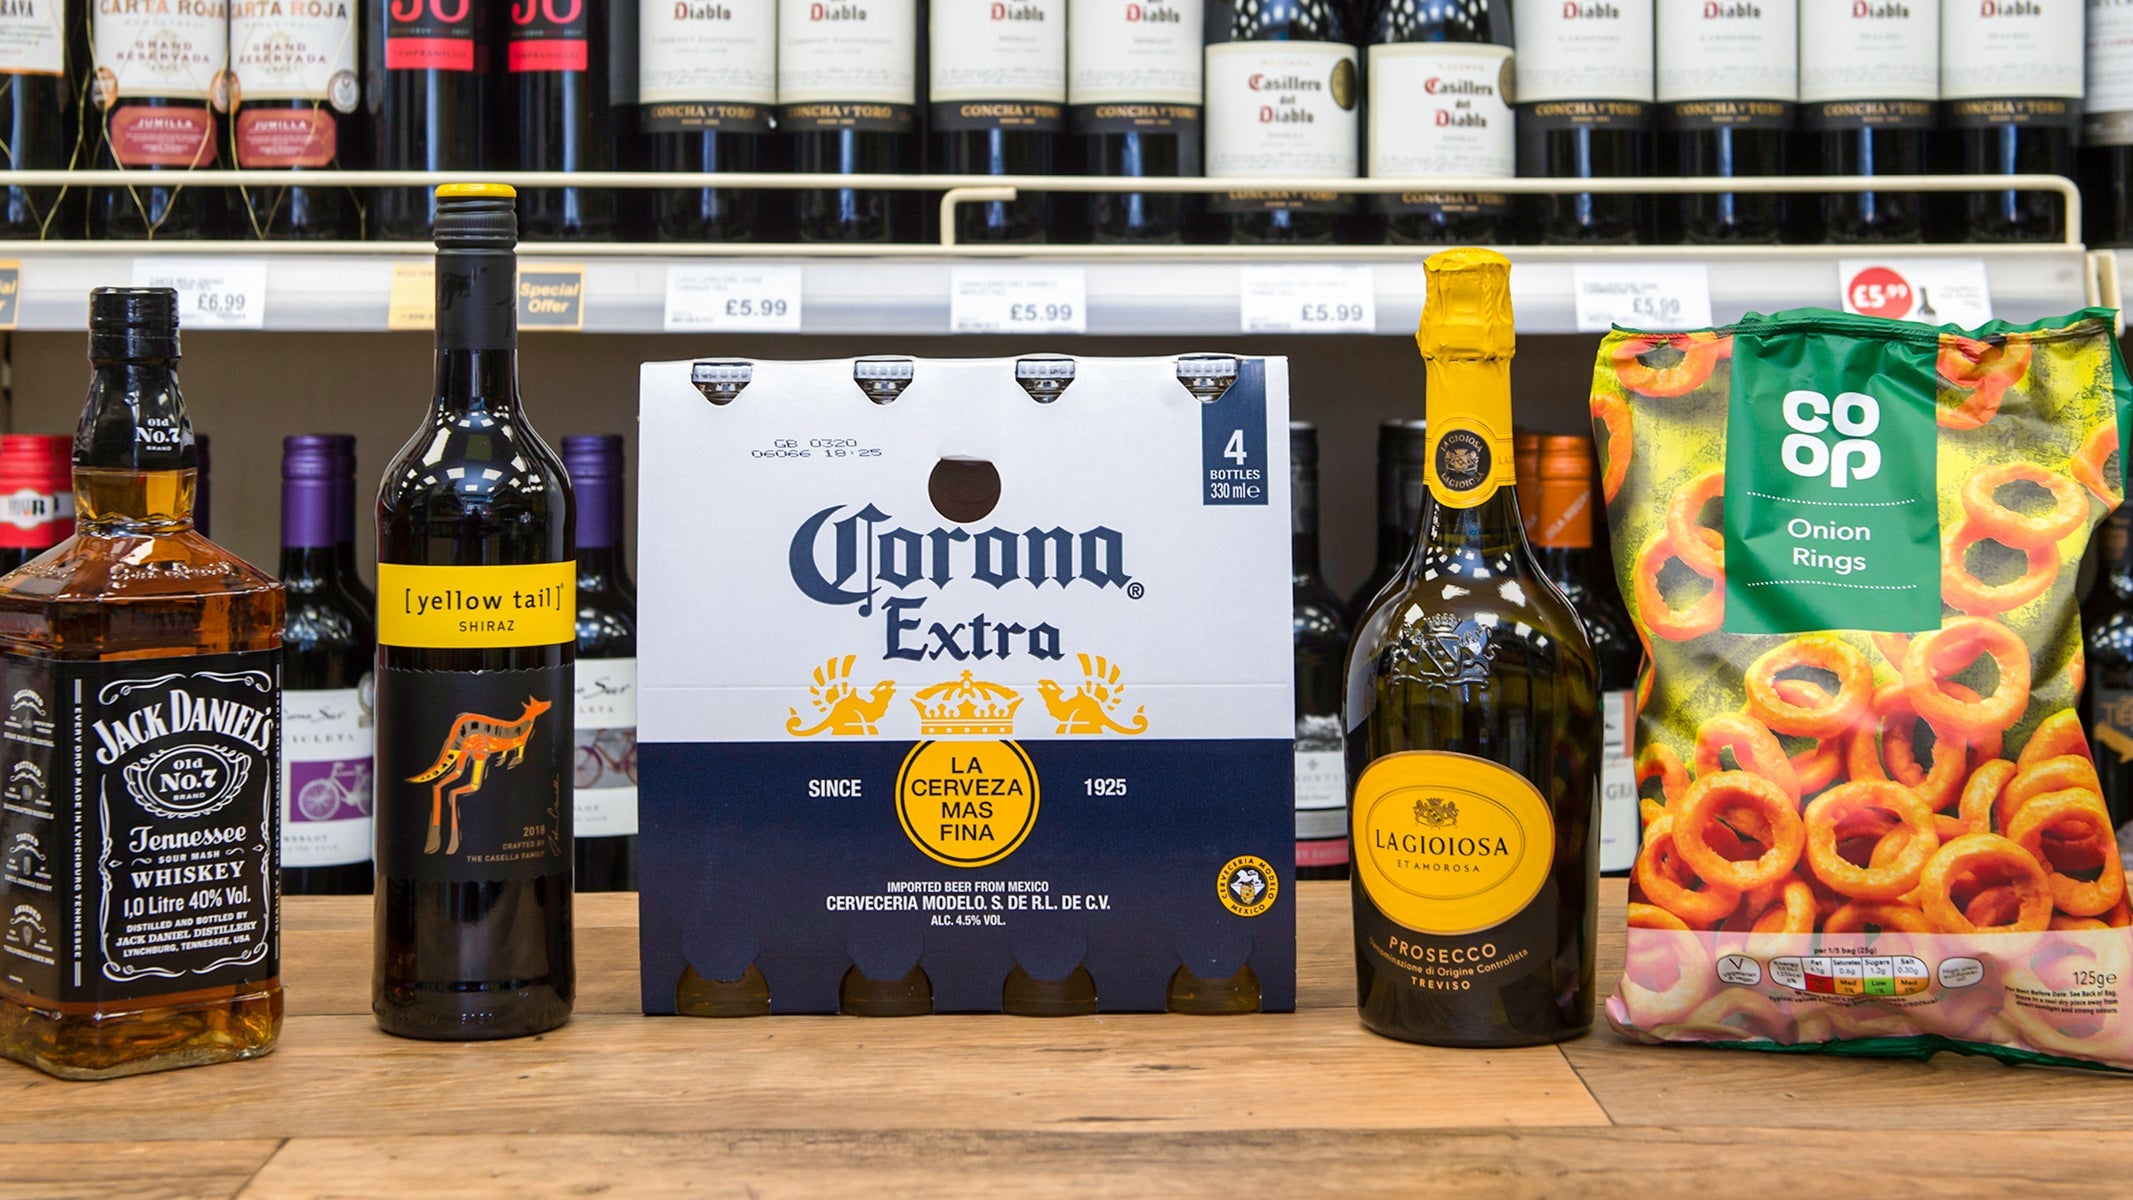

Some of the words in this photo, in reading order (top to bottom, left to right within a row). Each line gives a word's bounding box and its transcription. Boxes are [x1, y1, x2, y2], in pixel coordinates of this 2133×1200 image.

[674, 2, 732, 20] Diablo
[810, 3, 868, 22] Diablo
[990, 2, 1044, 22] Diablo
[1126, 4, 1180, 24] Diablo
[1562, 1, 1620, 19] Diablo
[1703, 1, 1761, 19] Diablo
[1852, 0, 1910, 19] Diablo
[1981, 0, 2041, 18] Diablo
[1249, 73, 1322, 91] Casillero
[1425, 77, 1494, 96] Casillero
[137, 117, 194, 129] JUMILLA
[1260, 106, 1315, 125] Diablo
[1435, 109, 1487, 129] Diablo
[255, 119, 308, 131] JUMILLA
[520, 282, 579, 298] Special
[197, 293, 245, 311] £6.99
[528, 299, 570, 314] Offer
[725, 298, 787, 317] £5.99
[1010, 303, 1073, 322] £5.99
[1301, 303, 1363, 322] £5.99
[147, 417, 169, 427] Old
[135, 427, 180, 443] No.7
[774, 438, 799, 449] GB
[809, 438, 858, 448] 0320
[751, 449, 812, 459] 06066
[1223, 429, 1247, 465] 4
[1210, 469, 1261, 481] BOTTLES
[1210, 482, 1231, 499] 330
[1787, 518, 1872, 542] Onion
[789, 502, 1133, 618] Corona
[1793, 547, 1868, 576] Rings
[458, 620, 516, 632] SHIRAZ
[881, 596, 1066, 662] Extra
[74, 707, 83, 743] EVERY
[92, 702, 171, 765] JACK
[169, 689, 274, 751] DANIEL'S
[74, 745, 83, 775] DROP
[173, 757, 203, 770] Old
[951, 757, 983, 774] LA
[159, 768, 219, 793] No.7
[808, 779, 863, 798] SINCE
[911, 779, 1024, 797] CERVEZA
[1084, 778, 1128, 797] 1925
[74, 777, 83, 809] MADE
[173, 792, 206, 801] BRAND
[74, 811, 83, 823] IN
[941, 801, 994, 819] MAS
[129, 826, 247, 853] Tennessee
[523, 825, 546, 837] 2018
[940, 824, 996, 841] FINA
[502, 840, 536, 850] CRAFTED
[537, 839, 546, 848] BY
[1375, 829, 1510, 857] LAGIOIOSA
[74, 825, 83, 891] LYNCHBURG
[158, 854, 187, 865] SOUR
[190, 850, 220, 861] MASH
[466, 855, 483, 863] THE
[484, 853, 520, 863] CASELLA
[521, 850, 545, 860] FAMILY
[130, 860, 246, 889] WHISKEY
[1219, 858, 1255, 899] CERVECERIA
[1258, 862, 1276, 900] MODELO
[887, 881, 942, 893] IMPORTED
[944, 881, 973, 893] BEER
[974, 881, 1006, 893] FROM
[1008, 881, 1050, 893] MEXICO
[149, 895, 184, 916] Litre
[188, 888, 223, 910] 40%
[226, 885, 251, 904] Vol.
[826, 895, 919, 911] CERVECERIA
[991, 895, 1005, 911] S.
[1007, 895, 1028, 911] DE
[1031, 895, 1059, 910] R.L.
[1062, 895, 1083, 910] DE
[1084, 895, 1112, 910] C.V.
[1231, 904, 1266, 915] MEXICO
[74, 894, 83, 959] TENNESSEE
[126, 919, 172, 934] DISTILLED
[174, 916, 193, 927] AND
[195, 912, 235, 926] BOTTLED
[236, 911, 249, 920] BY
[930, 914, 954, 926] ALC.
[955, 914, 982, 926] 4.5%
[983, 914, 1007, 926] VOL.
[115, 935, 147, 948] JACK
[147, 930, 192, 944] DANIEL
[193, 920, 258, 938] DISTILLERY
[122, 943, 180, 959] LYNCHBURG,
[181, 938, 232, 952] TENNESSEE,
[233, 934, 251, 944] USA
[1389, 935, 1497, 964] PROSECCO
[1842, 947, 1856, 955] bag
[1425, 964, 1435, 975] di
[1437, 966, 1475, 979] Origine
[1476, 948, 1529, 974] Controllata
[1864, 959, 1890, 967] Sugars
[1411, 976, 1472, 991] TREVISO
[1871, 979, 1887, 987] Low
